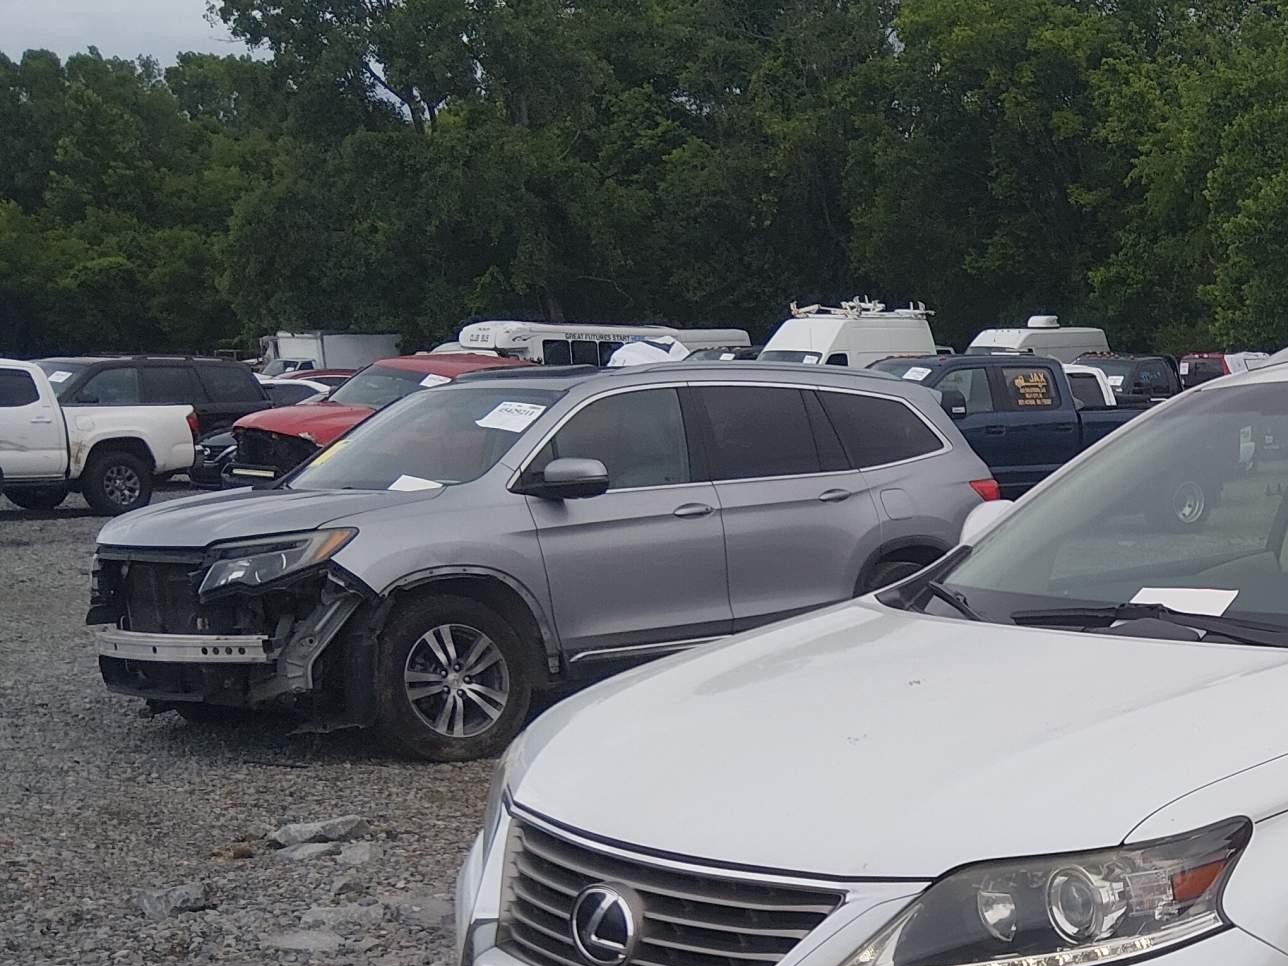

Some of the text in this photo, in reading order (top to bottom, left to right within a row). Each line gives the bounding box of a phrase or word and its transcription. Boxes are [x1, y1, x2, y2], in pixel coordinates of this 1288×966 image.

[564, 332, 584, 340] GREAT
[585, 333, 612, 341] FUTURES
[612, 334, 630, 342] START
[1029, 372, 1046, 383] JAX
